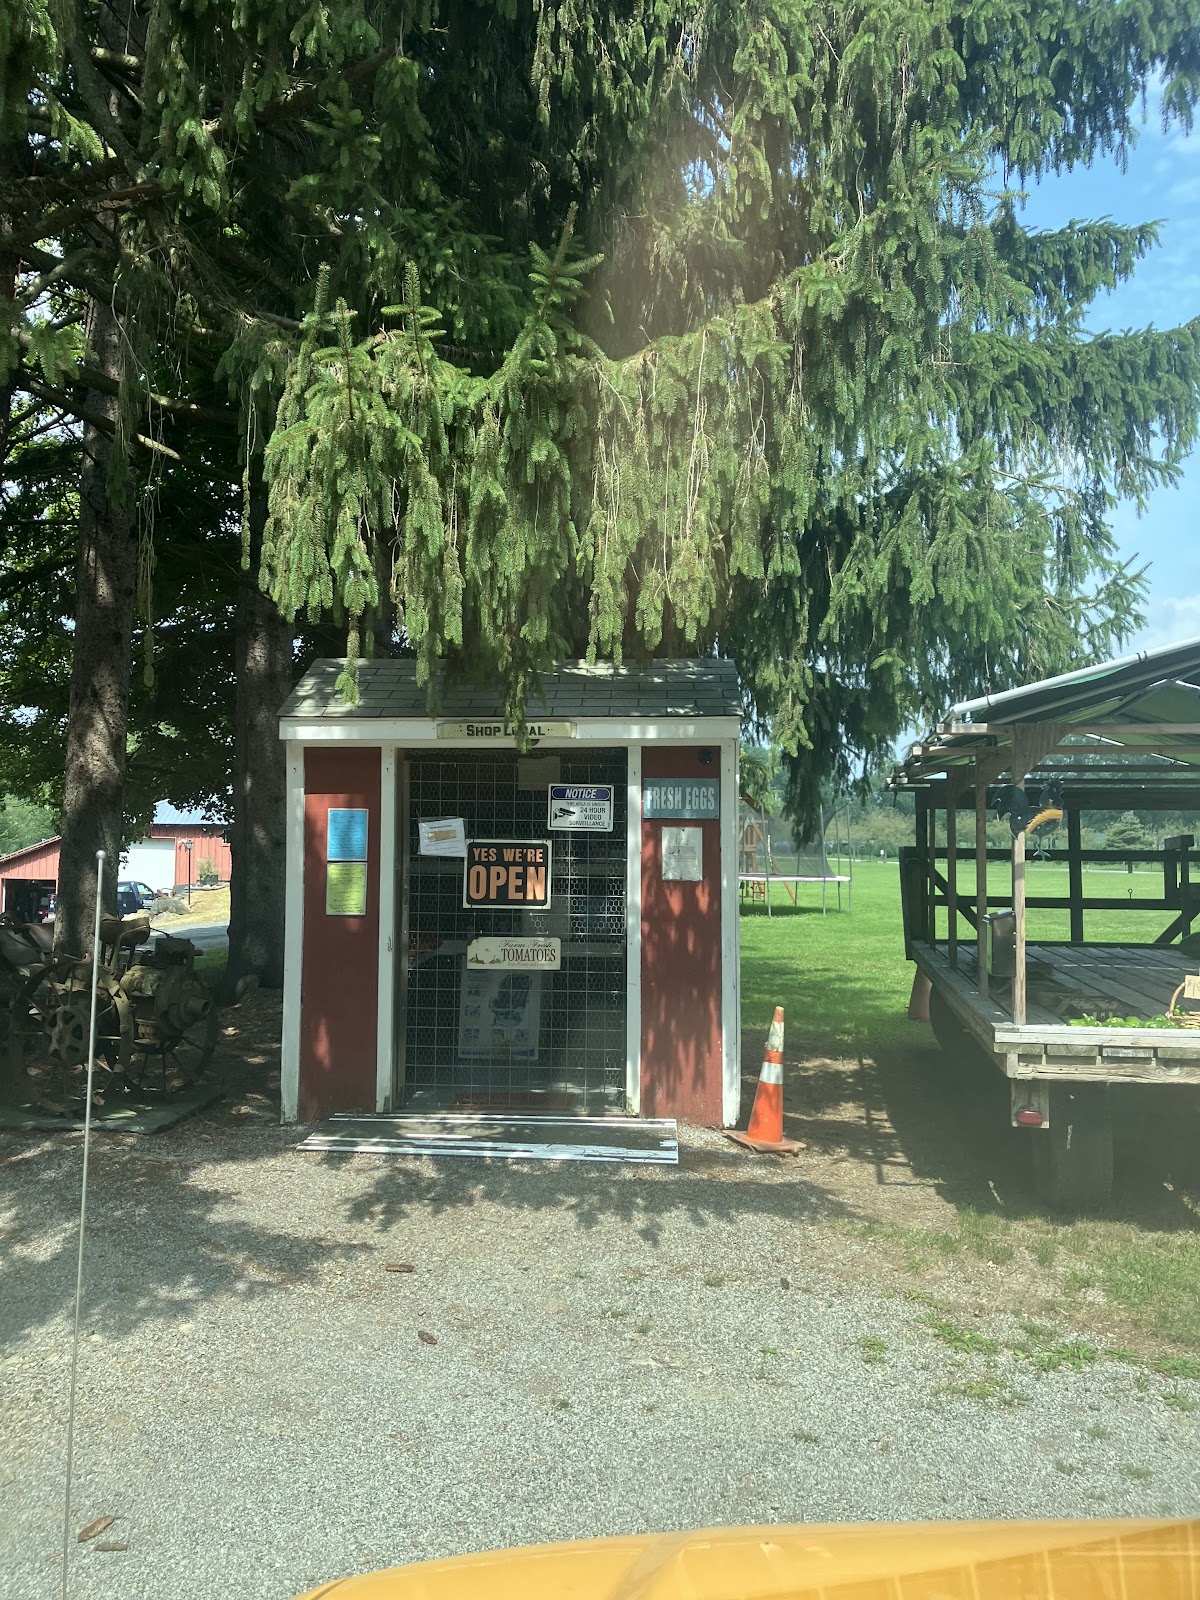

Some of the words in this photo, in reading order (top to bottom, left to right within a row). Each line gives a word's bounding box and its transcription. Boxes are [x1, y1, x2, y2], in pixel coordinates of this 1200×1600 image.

[466, 725, 501, 736] SHOP
[504, 726, 545, 736] LAL
[565, 788, 597, 799] NOTICE
[647, 786, 682, 810] FRESH
[685, 786, 715, 810] EGGS
[473, 848, 497, 862] YES
[503, 848, 544, 863] WE'RE
[469, 865, 546, 900] OPEN
[499, 940, 526, 948] Farm
[527, 940, 553, 948] Fresh
[501, 948, 556, 962] TOMATOES
